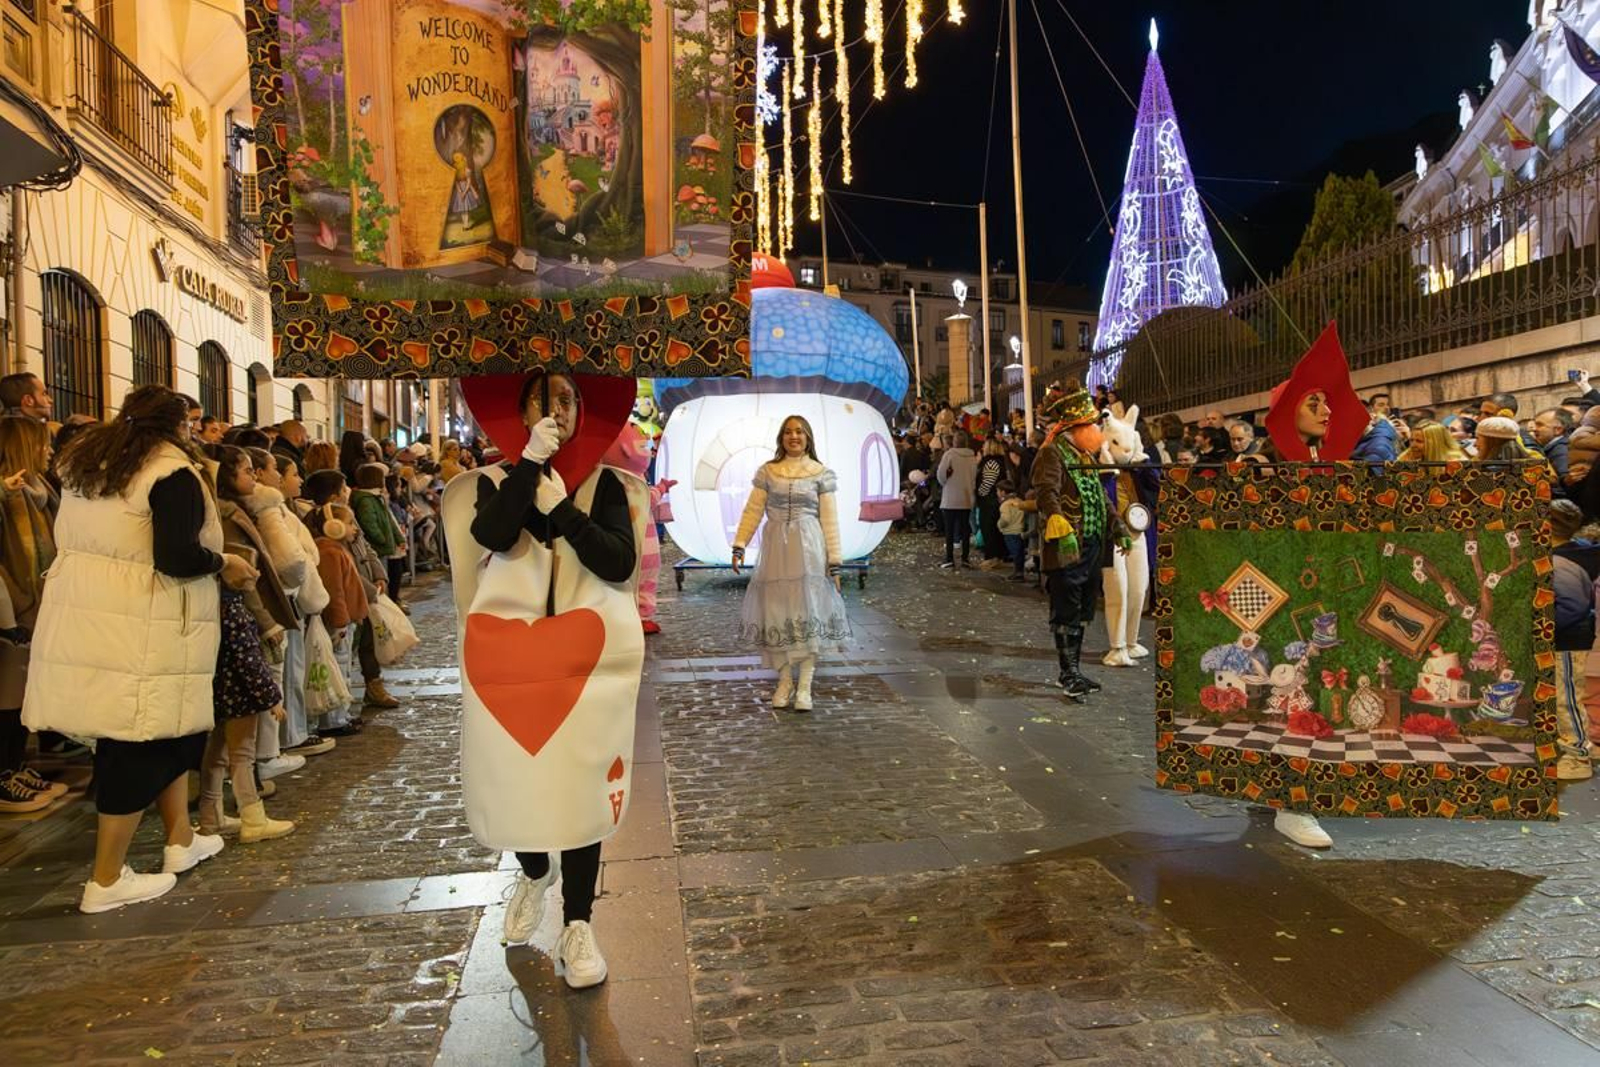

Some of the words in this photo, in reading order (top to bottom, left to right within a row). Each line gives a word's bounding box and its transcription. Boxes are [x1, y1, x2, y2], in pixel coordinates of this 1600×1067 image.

[419, 17, 496, 54] WELCOME
[450, 45, 469, 66] TO
[406, 71, 508, 113] WONDERLAND
[178, 266, 215, 306] CAJA
[216, 287, 247, 323] RURAL
[608, 789, 625, 825] A
